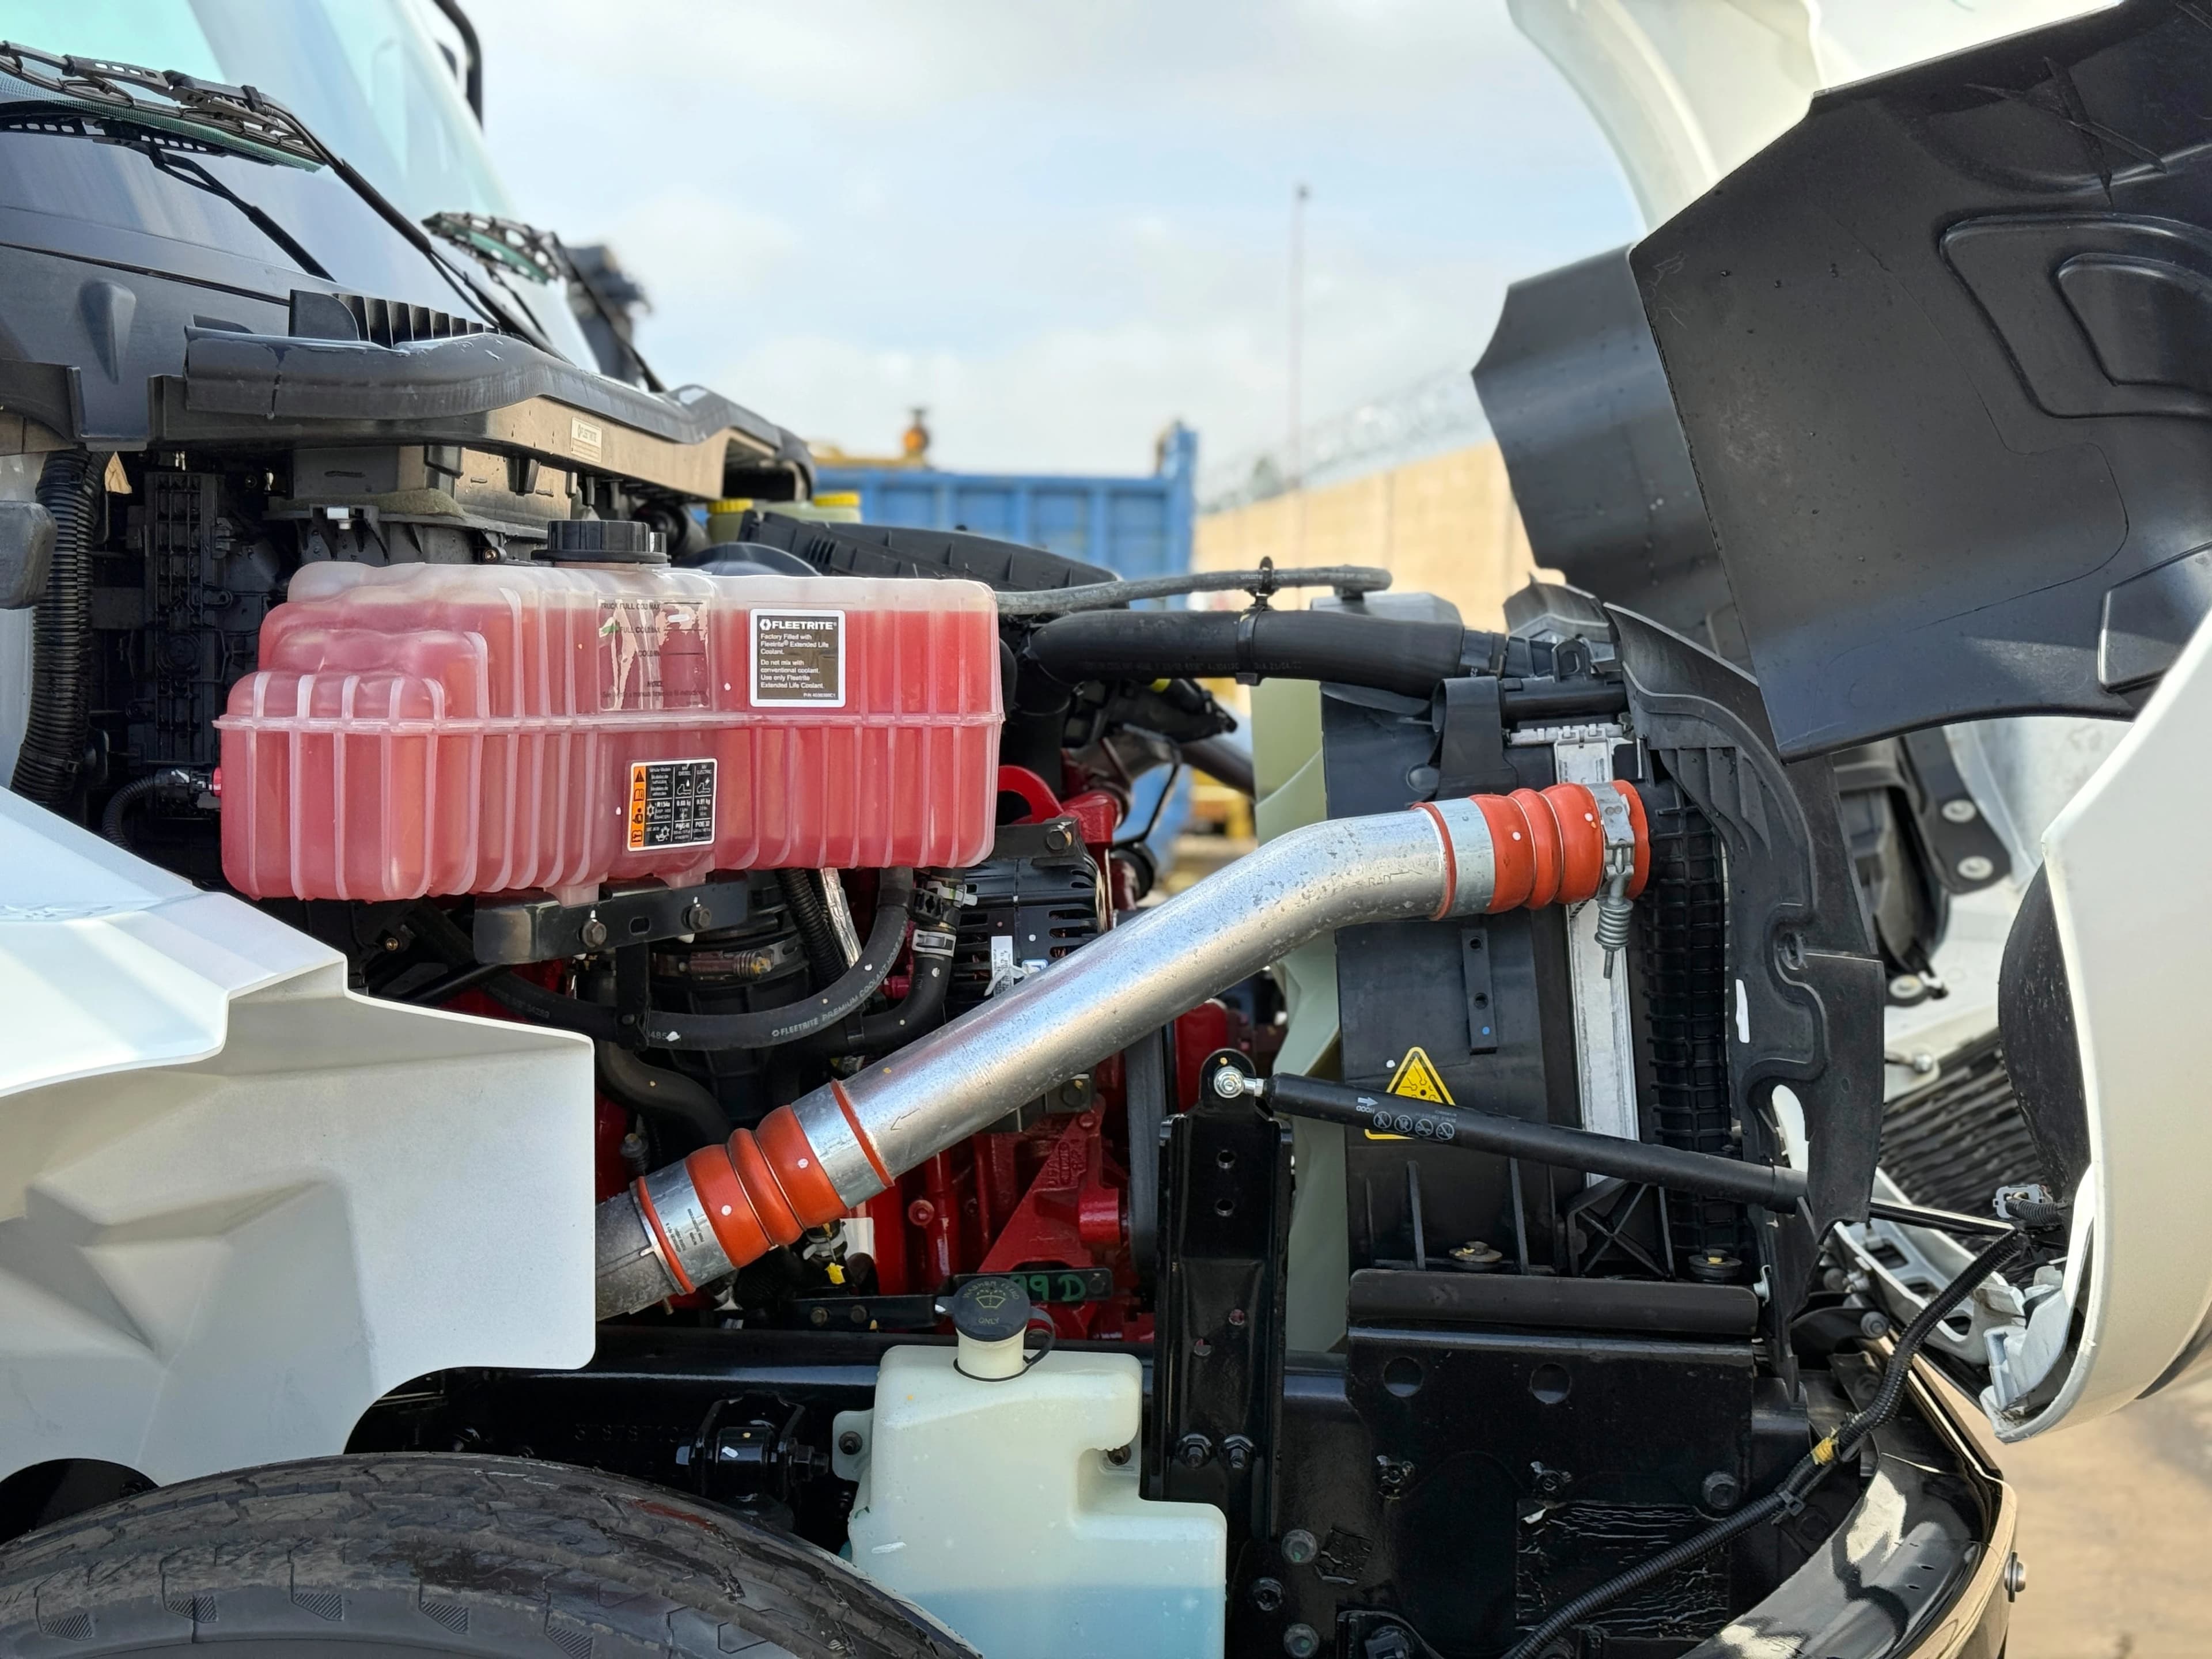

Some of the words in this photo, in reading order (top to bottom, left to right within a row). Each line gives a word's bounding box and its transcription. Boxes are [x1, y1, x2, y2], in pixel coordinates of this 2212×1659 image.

[780, 1017, 819, 1036] FLEETRITE
[821, 995, 858, 1022] PREMIUM
[859, 963, 887, 998] COOLANT
[887, 942, 900, 966] HOSE
[1355, 1105, 1376, 1114] HOOD
[962, 1281, 997, 1298] WASHER
[1000, 1282, 1020, 1300] FLUID
[1057, 1274, 1086, 1302] D
